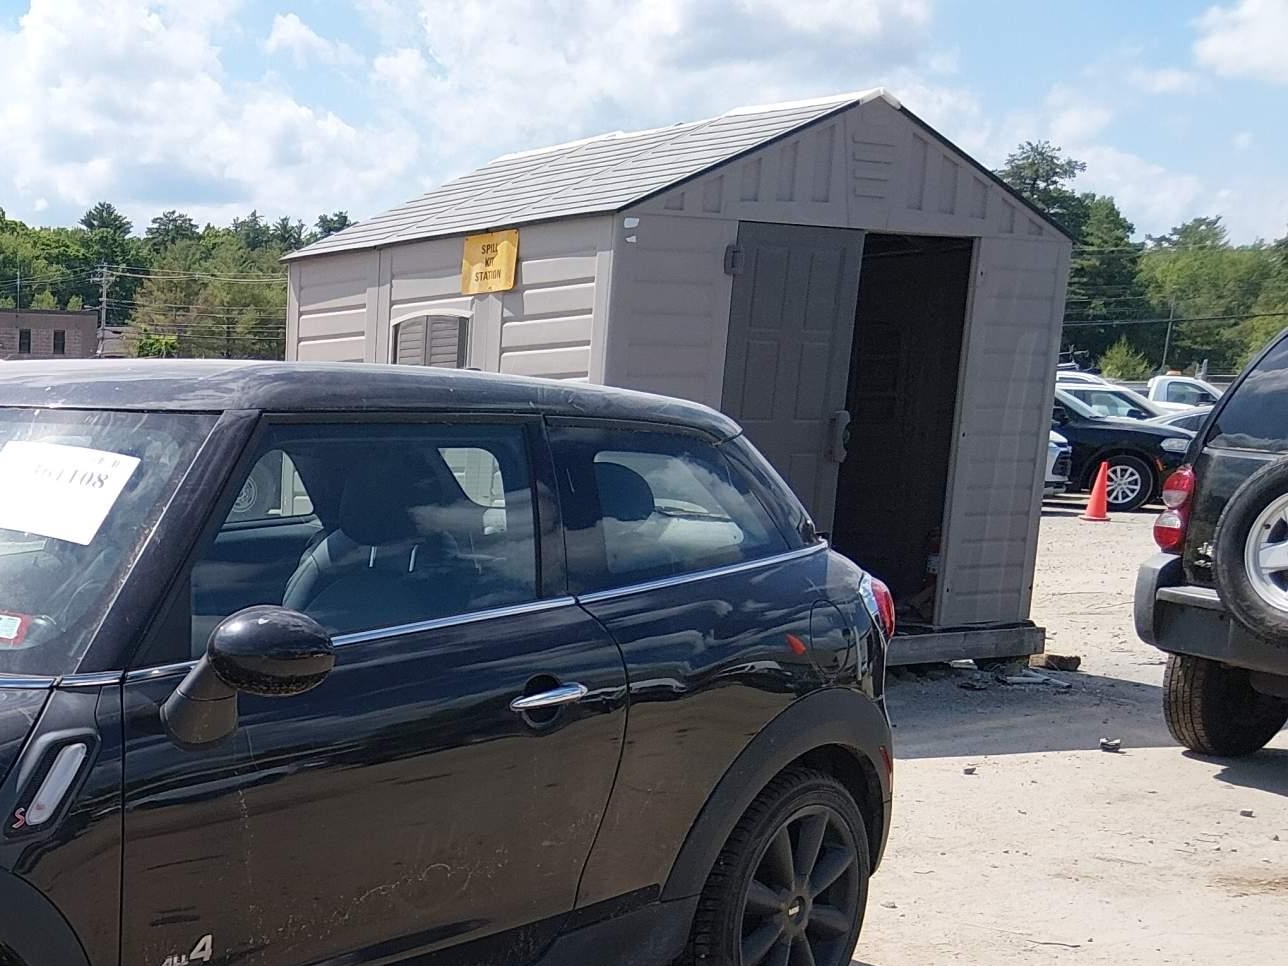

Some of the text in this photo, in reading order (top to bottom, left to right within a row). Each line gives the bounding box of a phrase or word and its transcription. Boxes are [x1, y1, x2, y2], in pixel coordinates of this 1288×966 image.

[481, 243, 498, 255] SPILL
[485, 256, 494, 267] KIT
[475, 269, 501, 281] STATION
[11, 807, 26, 829] S
